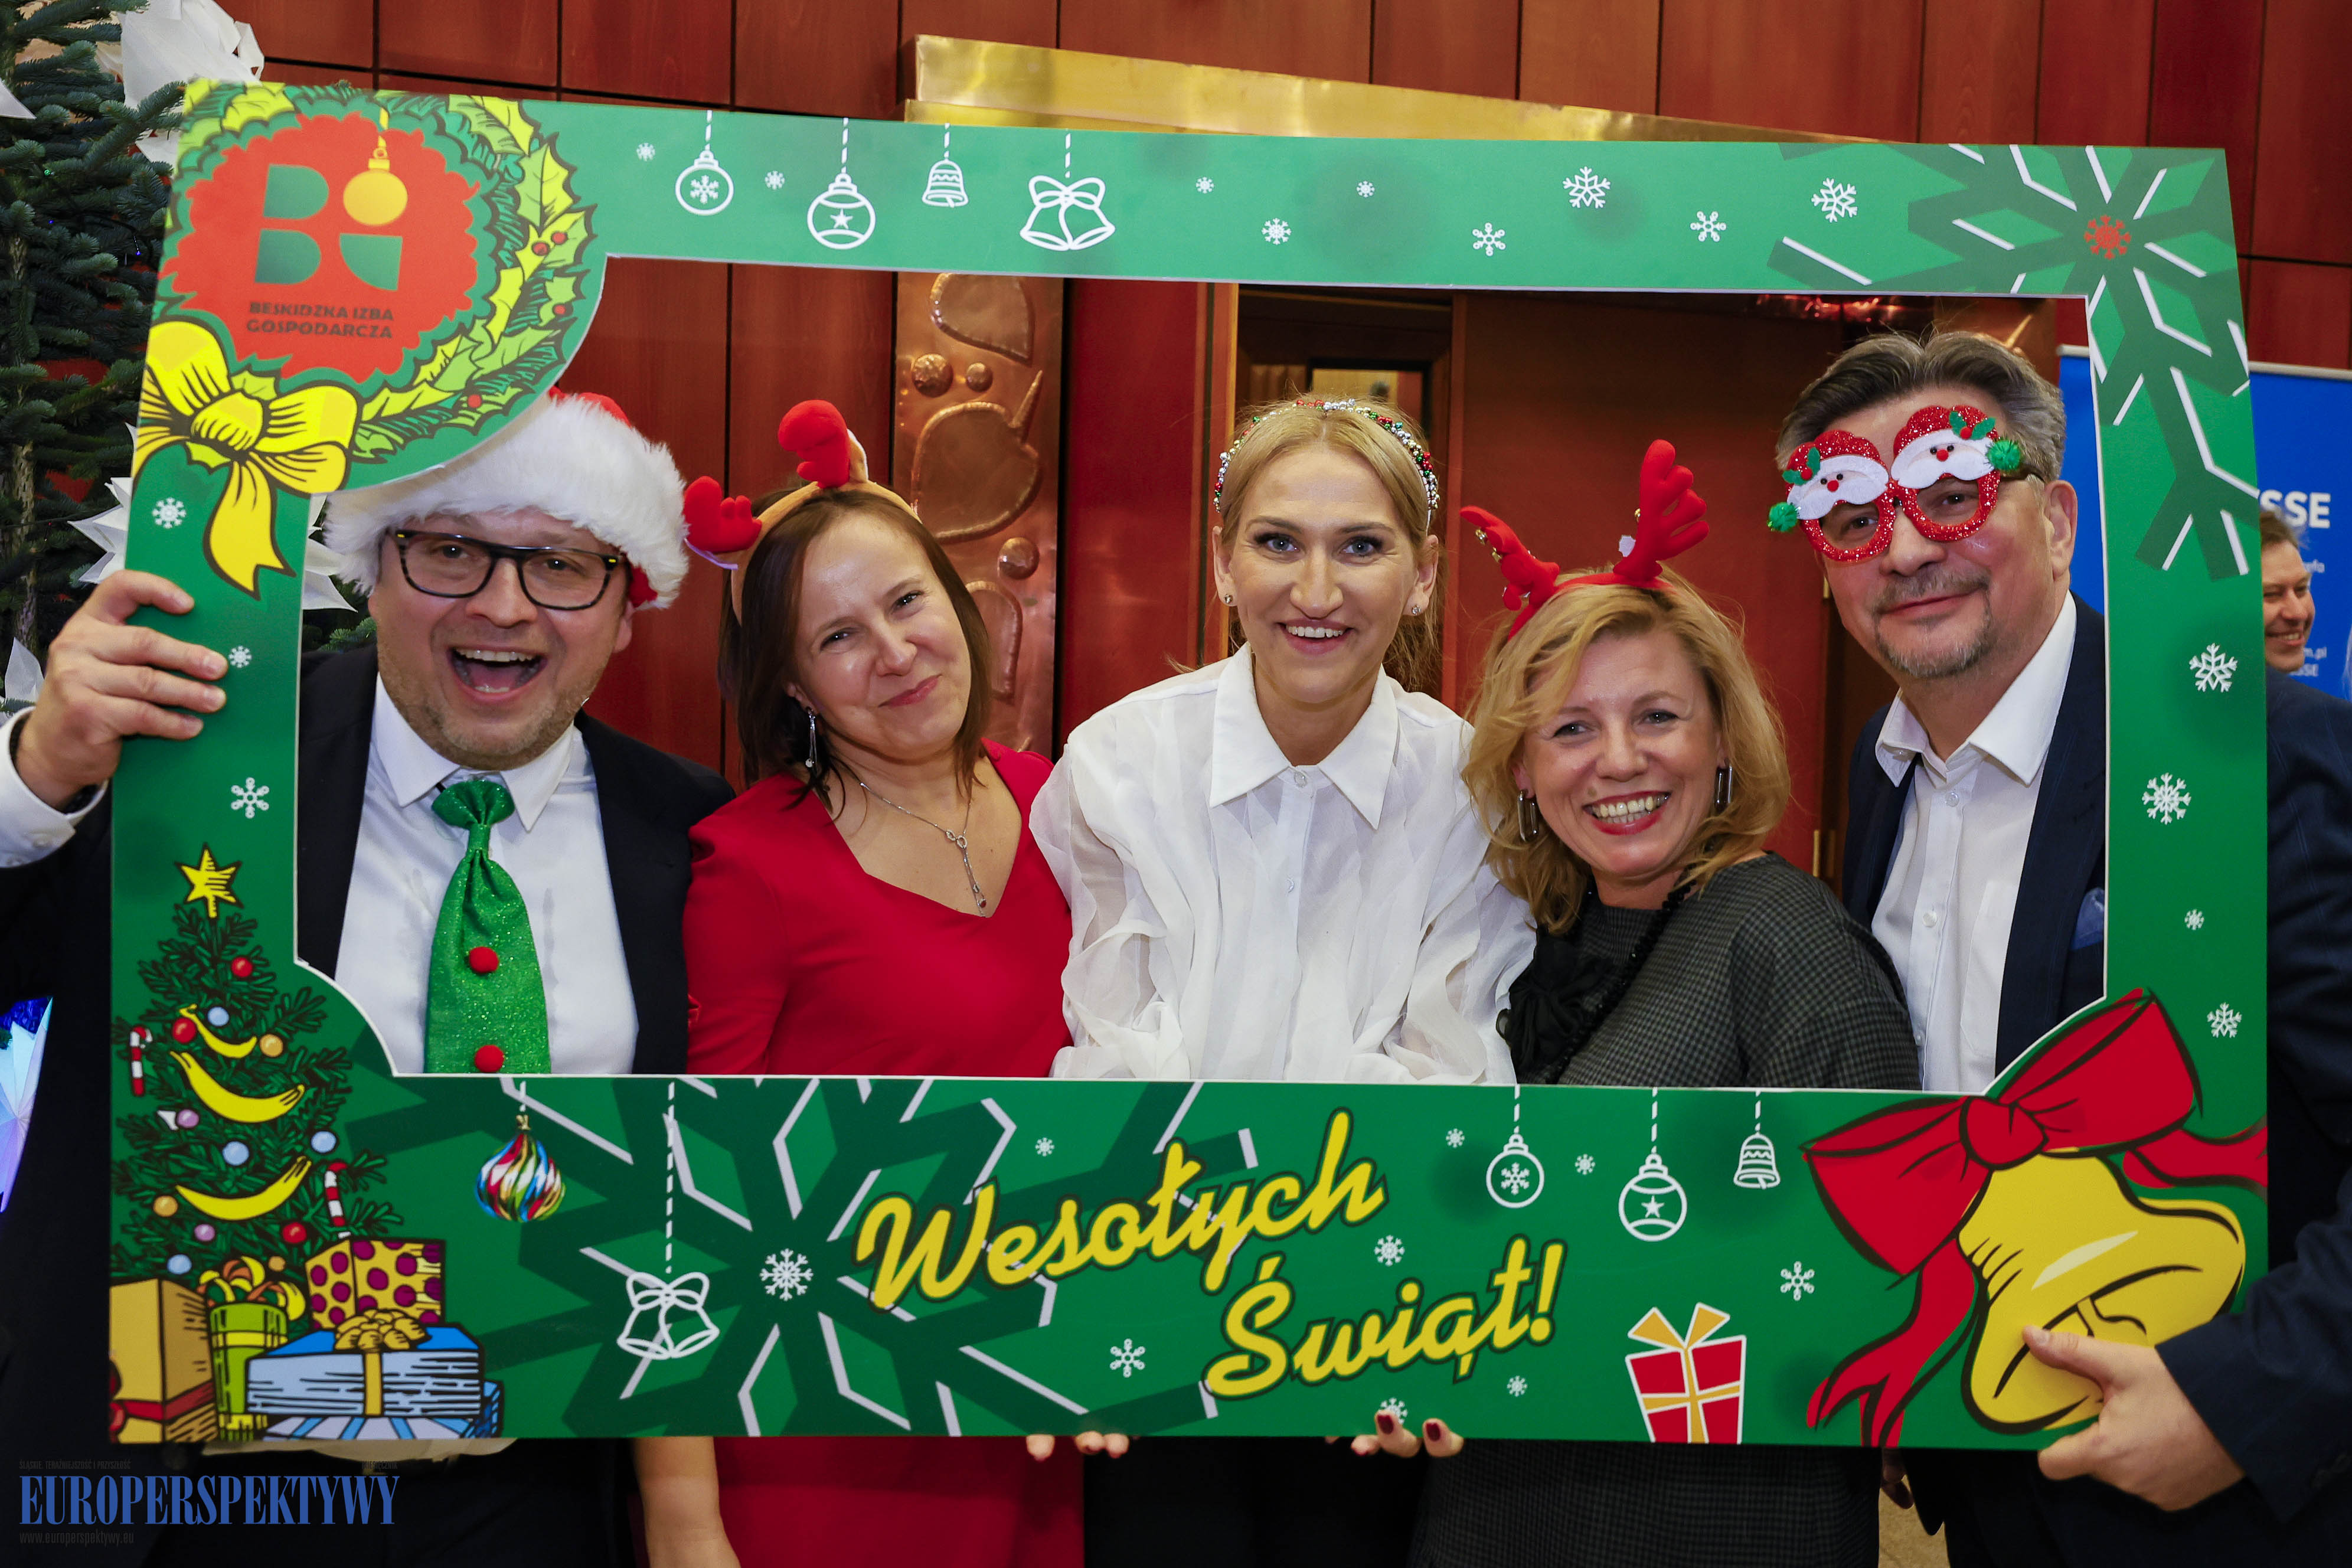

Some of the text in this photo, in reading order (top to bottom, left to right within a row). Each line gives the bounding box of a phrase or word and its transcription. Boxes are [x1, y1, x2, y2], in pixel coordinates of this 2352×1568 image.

[246, 319, 393, 338] GOSPODARCZA
[250, 301, 393, 321] BESKIDZKA IZBA
[854, 1108, 1385, 1311] Wesołych
[1203, 1237, 1566, 1397] Świąt!
